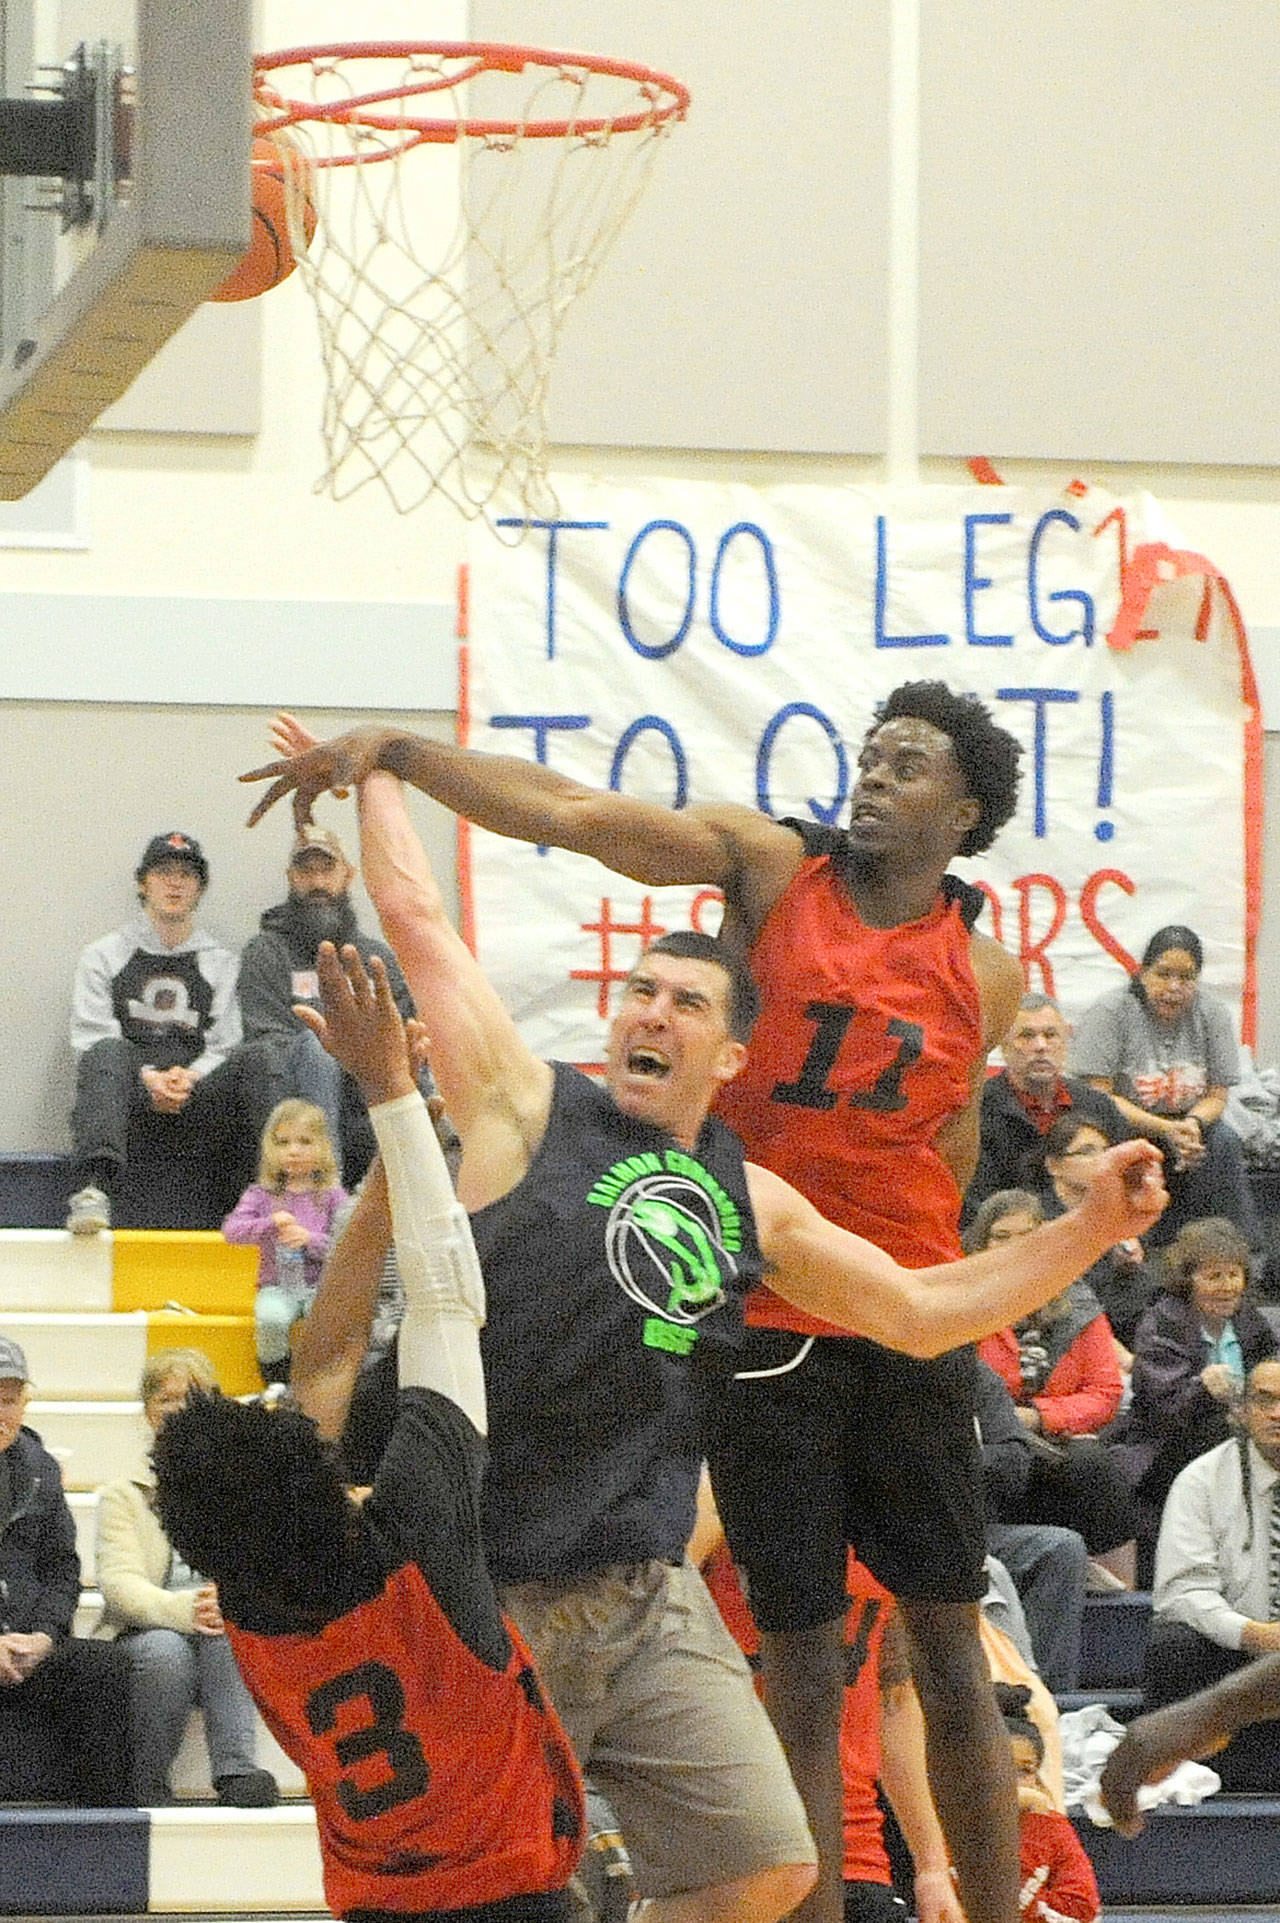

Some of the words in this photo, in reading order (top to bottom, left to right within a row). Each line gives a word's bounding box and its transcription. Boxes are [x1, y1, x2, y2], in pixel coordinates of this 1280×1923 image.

[497, 518, 782, 660] TOO
[490, 714, 688, 857] TO
[756, 688, 1115, 843] QT!
[308, 1662, 430, 1821] 3
